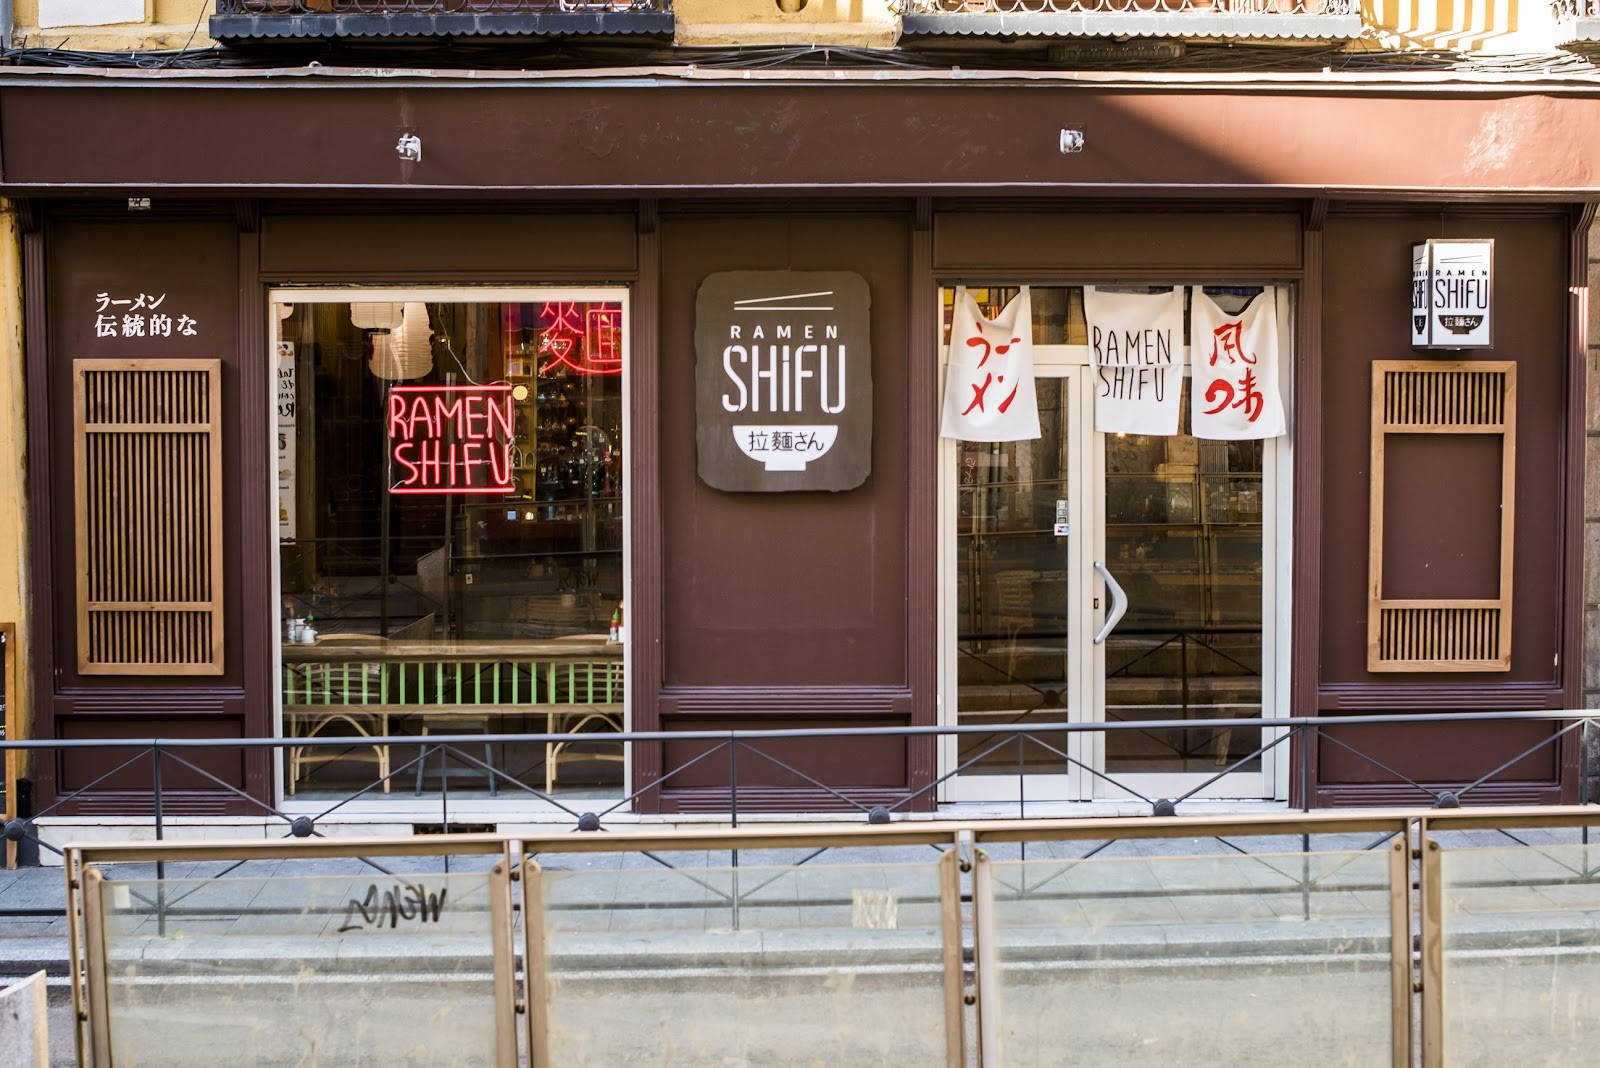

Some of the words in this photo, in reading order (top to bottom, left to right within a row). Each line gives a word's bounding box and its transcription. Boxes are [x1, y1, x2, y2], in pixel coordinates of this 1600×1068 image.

[95, 292, 166, 313] ラーメン
[94, 313, 198, 338] 伝統的な
[730, 325, 838, 339] RAMEN
[1093, 325, 1171, 365] RAMEN
[1099, 365, 1165, 402] SHIFU
[389, 394, 513, 440] RAMEN
[394, 440, 510, 486] SHIFU
